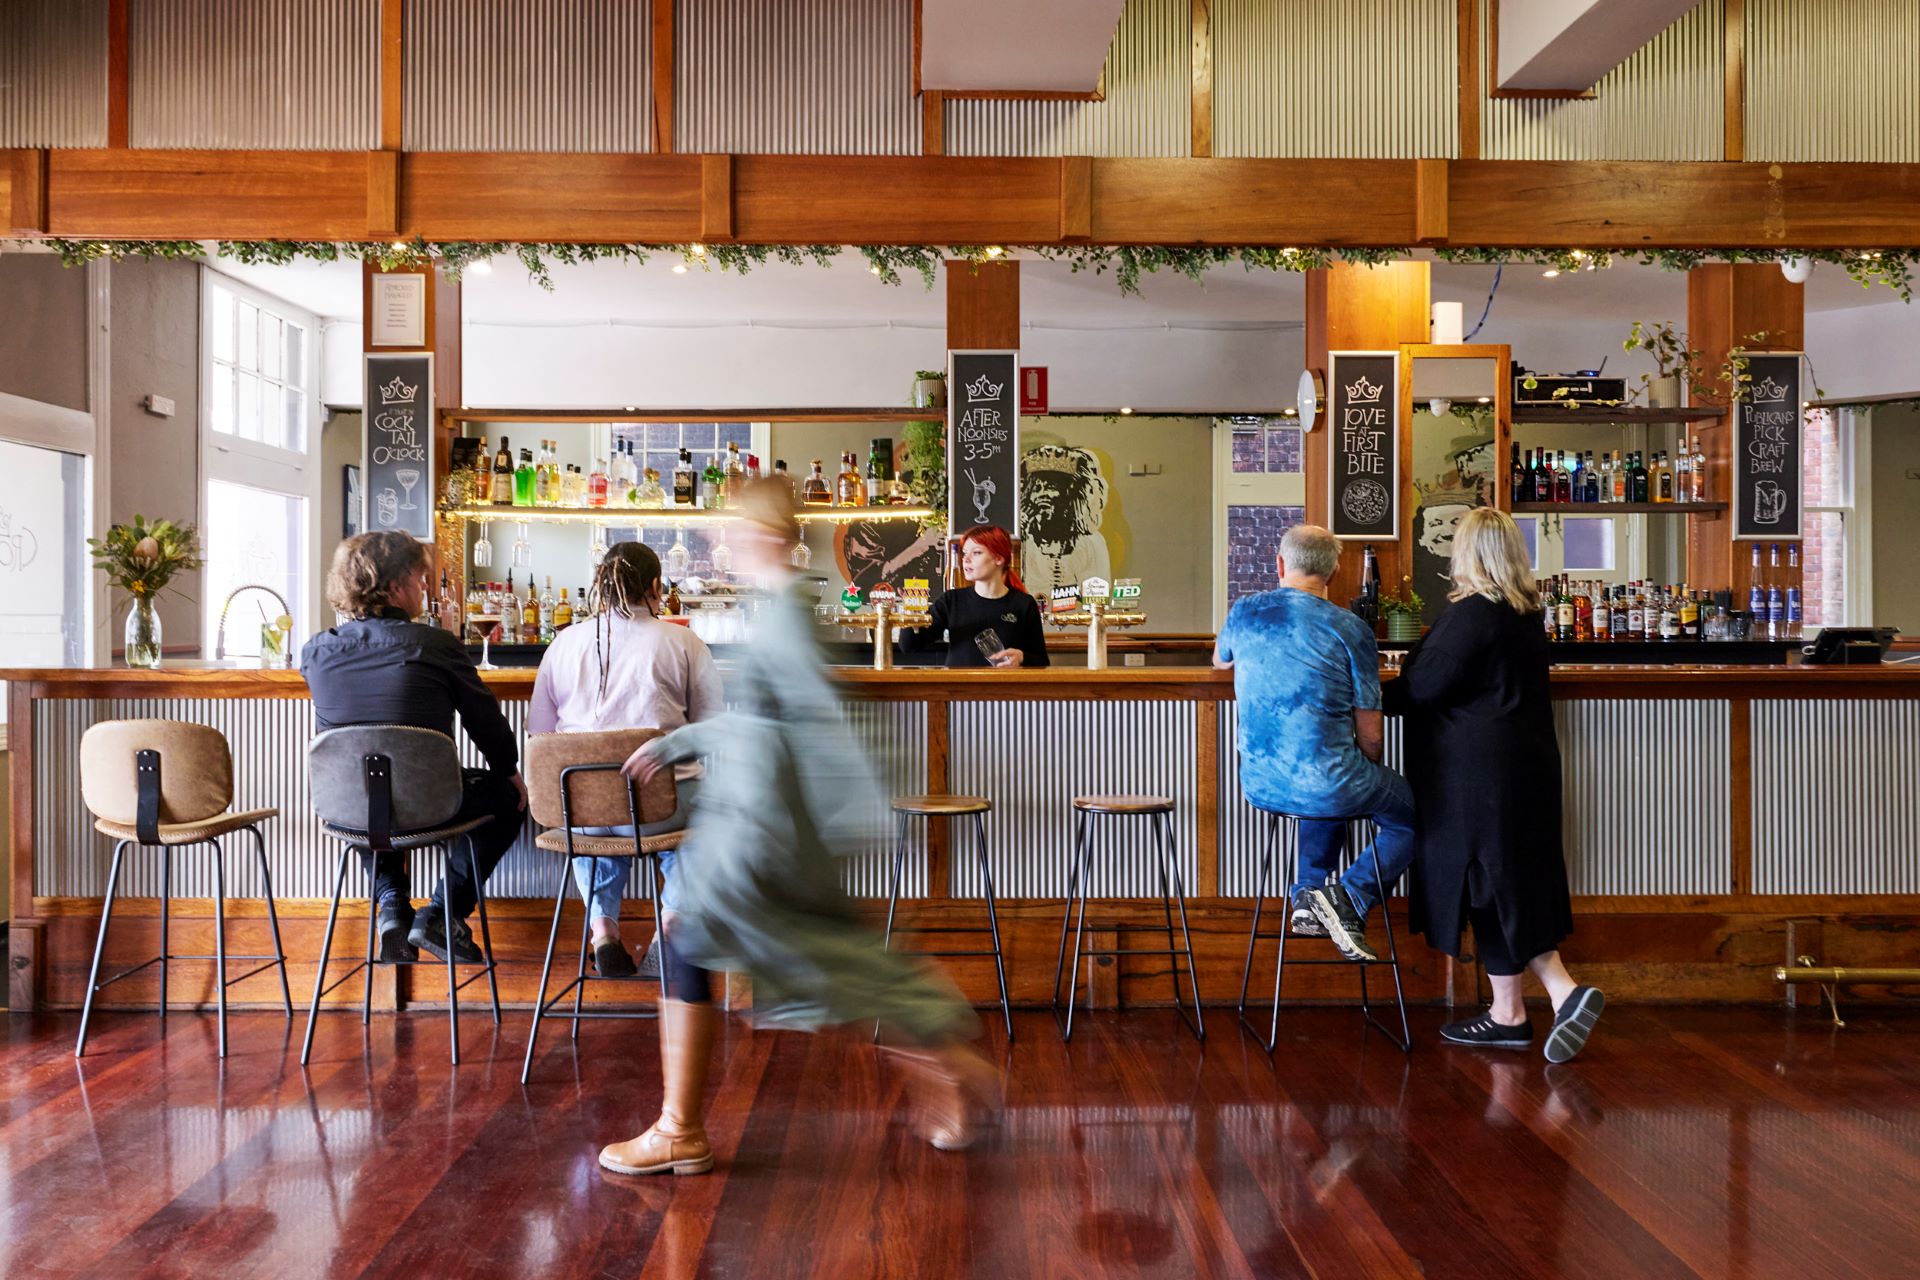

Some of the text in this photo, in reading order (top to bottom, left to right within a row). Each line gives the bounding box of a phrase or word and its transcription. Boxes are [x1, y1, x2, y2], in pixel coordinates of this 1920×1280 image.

[374, 412, 415, 432] COCK
[960, 408, 1002, 427] AFTER
[1343, 408, 1386, 430] LOVE
[387, 429, 422, 448] TAIL
[957, 427, 1009, 443] NOONSIES
[1358, 426, 1372, 437] AT
[1754, 425, 1786, 441] PICK
[1343, 431, 1386, 453] FIRST
[1748, 440, 1790, 459] CRAFT
[1347, 452, 1385, 475] BITE
[1750, 458, 1785, 474] BREW
[869, 589, 897, 600] SWAN
[1051, 586, 1080, 599] HAHN
[1114, 586, 1141, 598] TED
